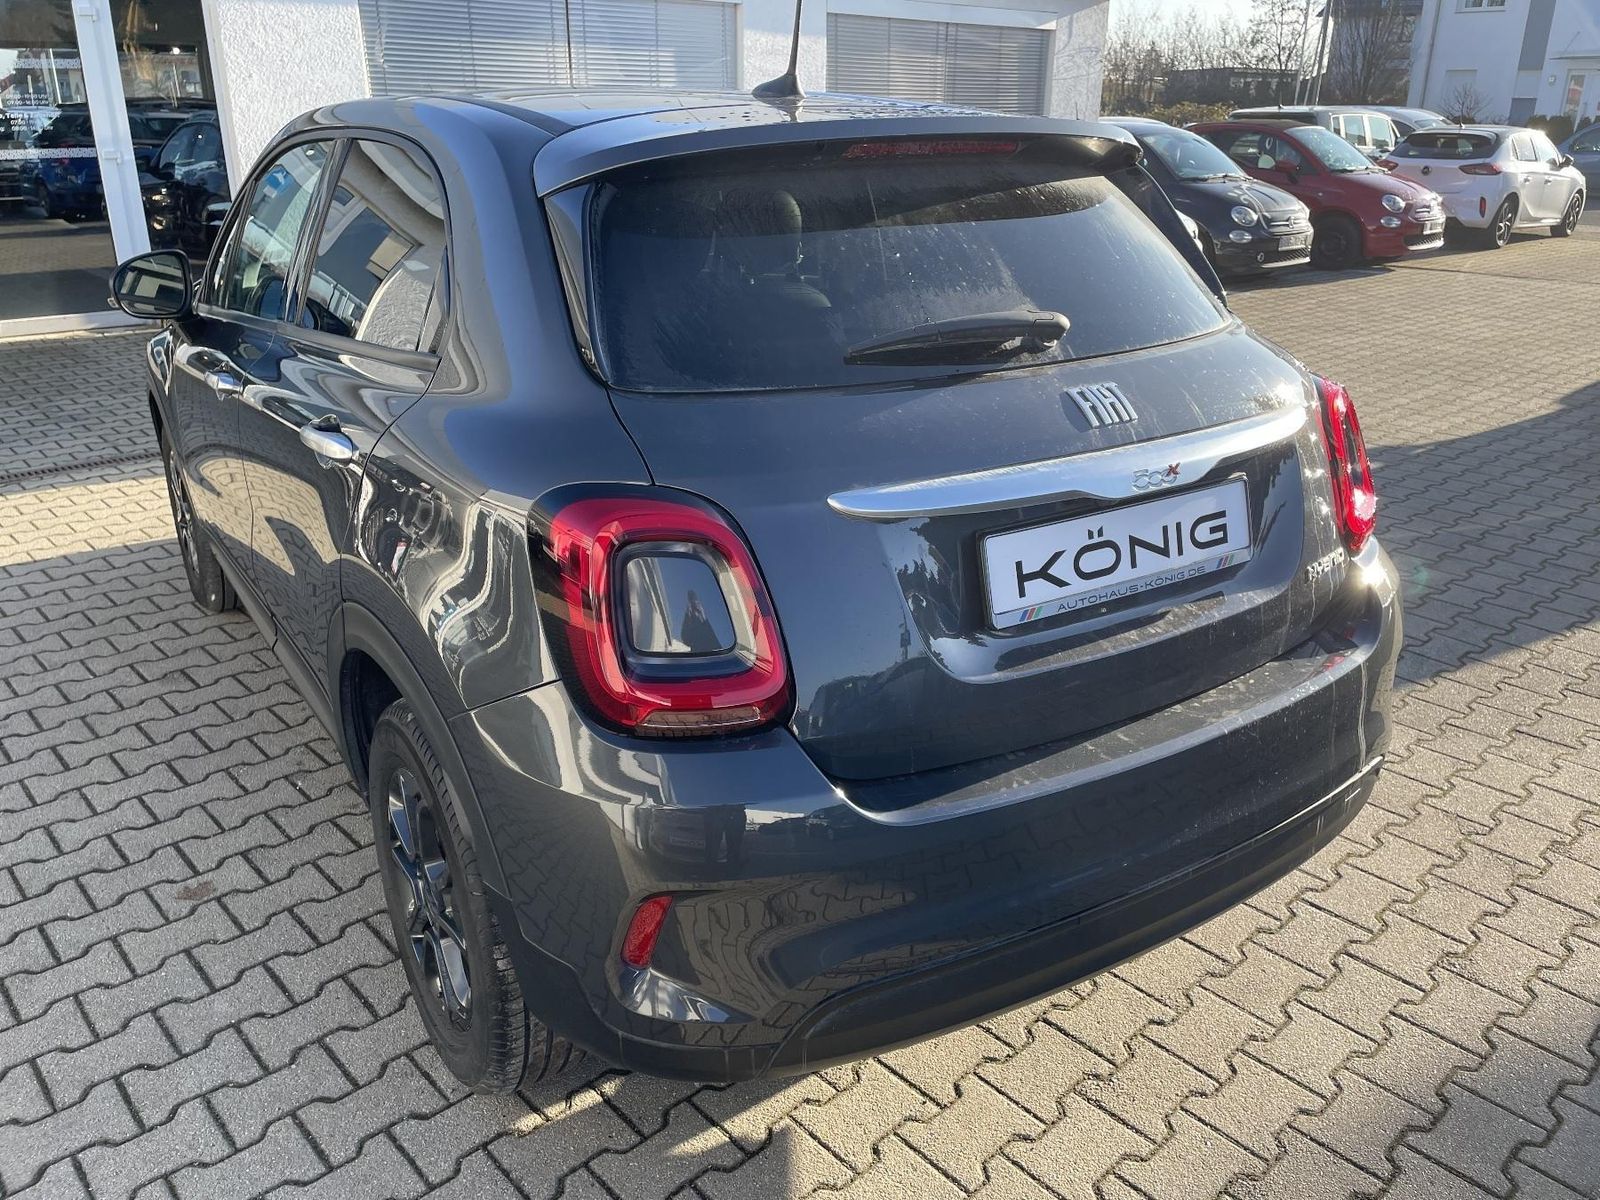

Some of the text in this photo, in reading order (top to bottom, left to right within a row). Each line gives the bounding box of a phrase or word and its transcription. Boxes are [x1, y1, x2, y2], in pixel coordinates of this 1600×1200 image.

[1064, 381, 1139, 429] FIAT
[1015, 510, 1229, 598] KÖNIG
[1057, 566, 1206, 612] AUTOHAUS-KÖNIG.DE
